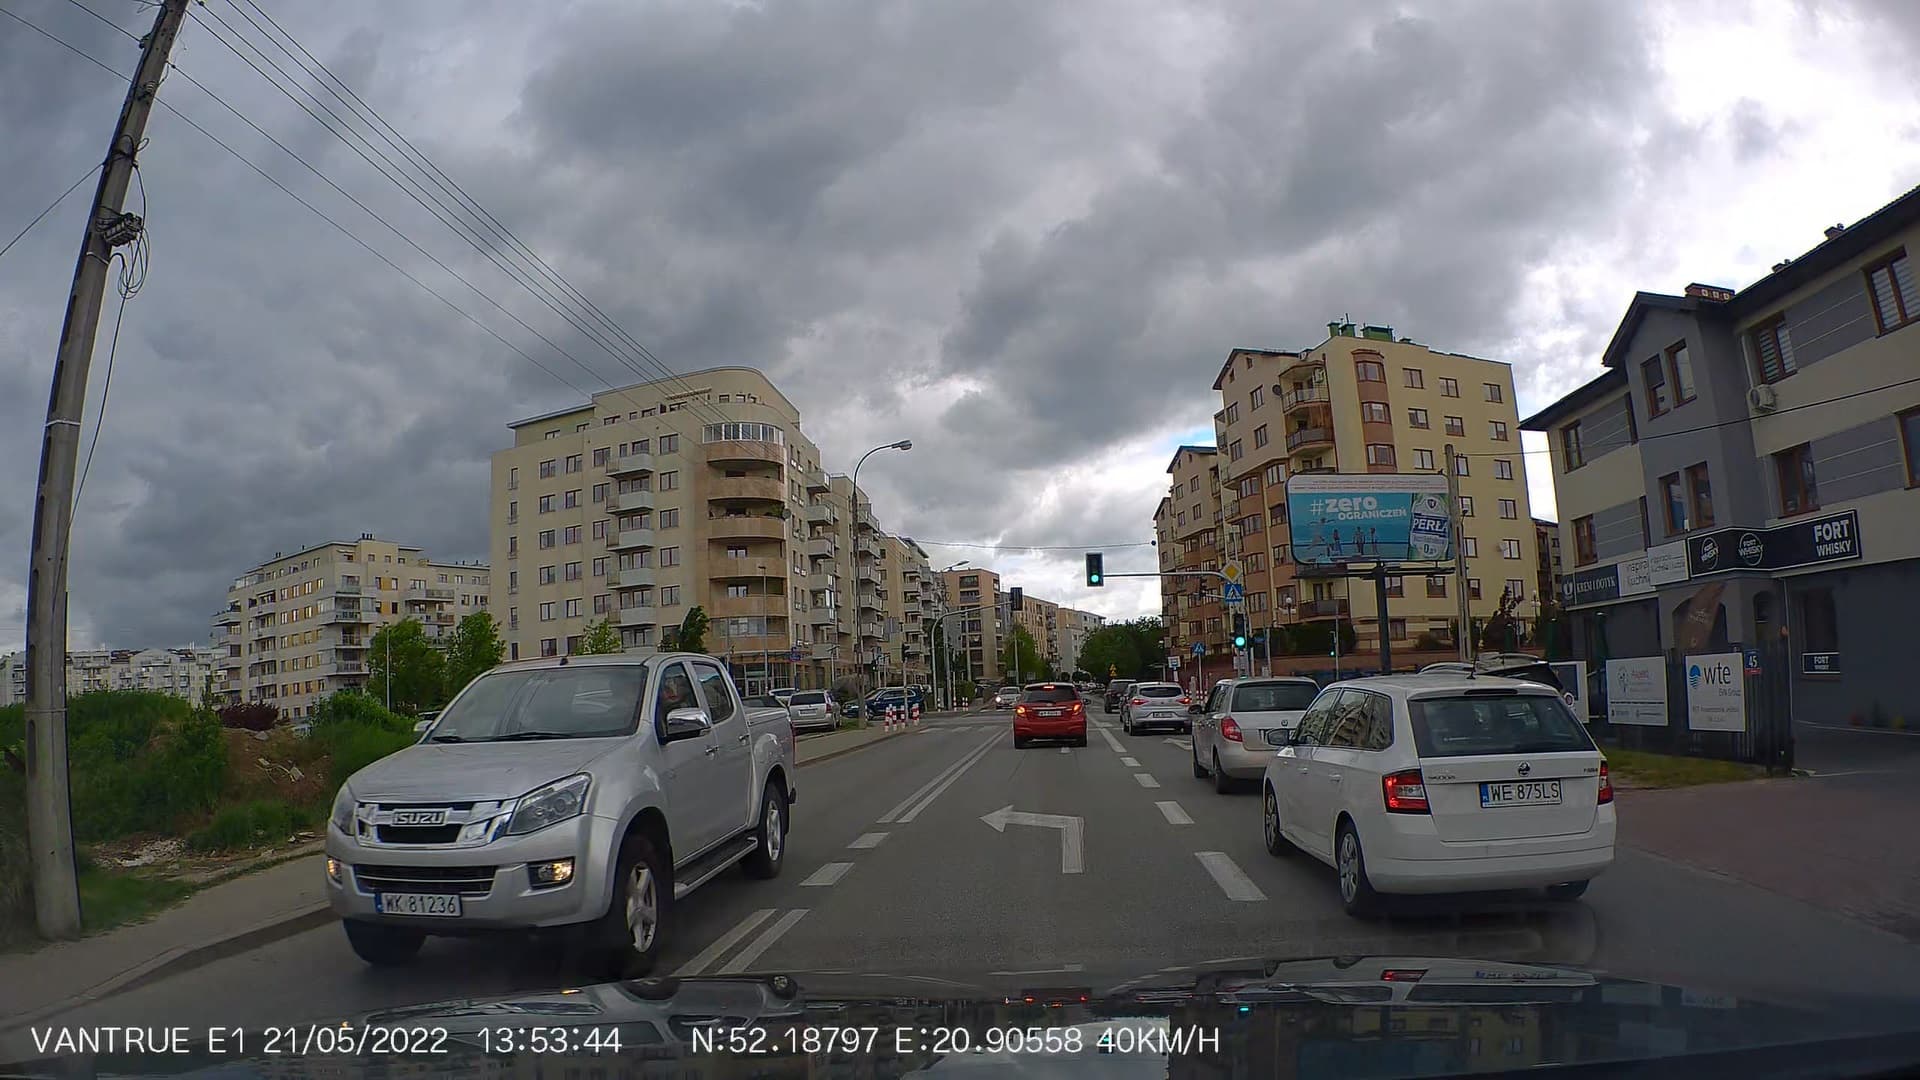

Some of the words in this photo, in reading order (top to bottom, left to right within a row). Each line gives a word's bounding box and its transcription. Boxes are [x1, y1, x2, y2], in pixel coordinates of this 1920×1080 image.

[1309, 496, 1378, 516] #zero
[1813, 519, 1850, 543] FORT
[1815, 539, 1852, 557] WHISKY
[1748, 655, 1758, 668] 45
[1814, 656, 1829, 665] FORT
[1704, 662, 1731, 685] wte
[1491, 784, 1512, 801] WE
[1517, 782, 1559, 800] 875LS
[393, 812, 446, 825] ISUZU
[385, 895, 404, 912] WK
[408, 895, 456, 914] 81236
